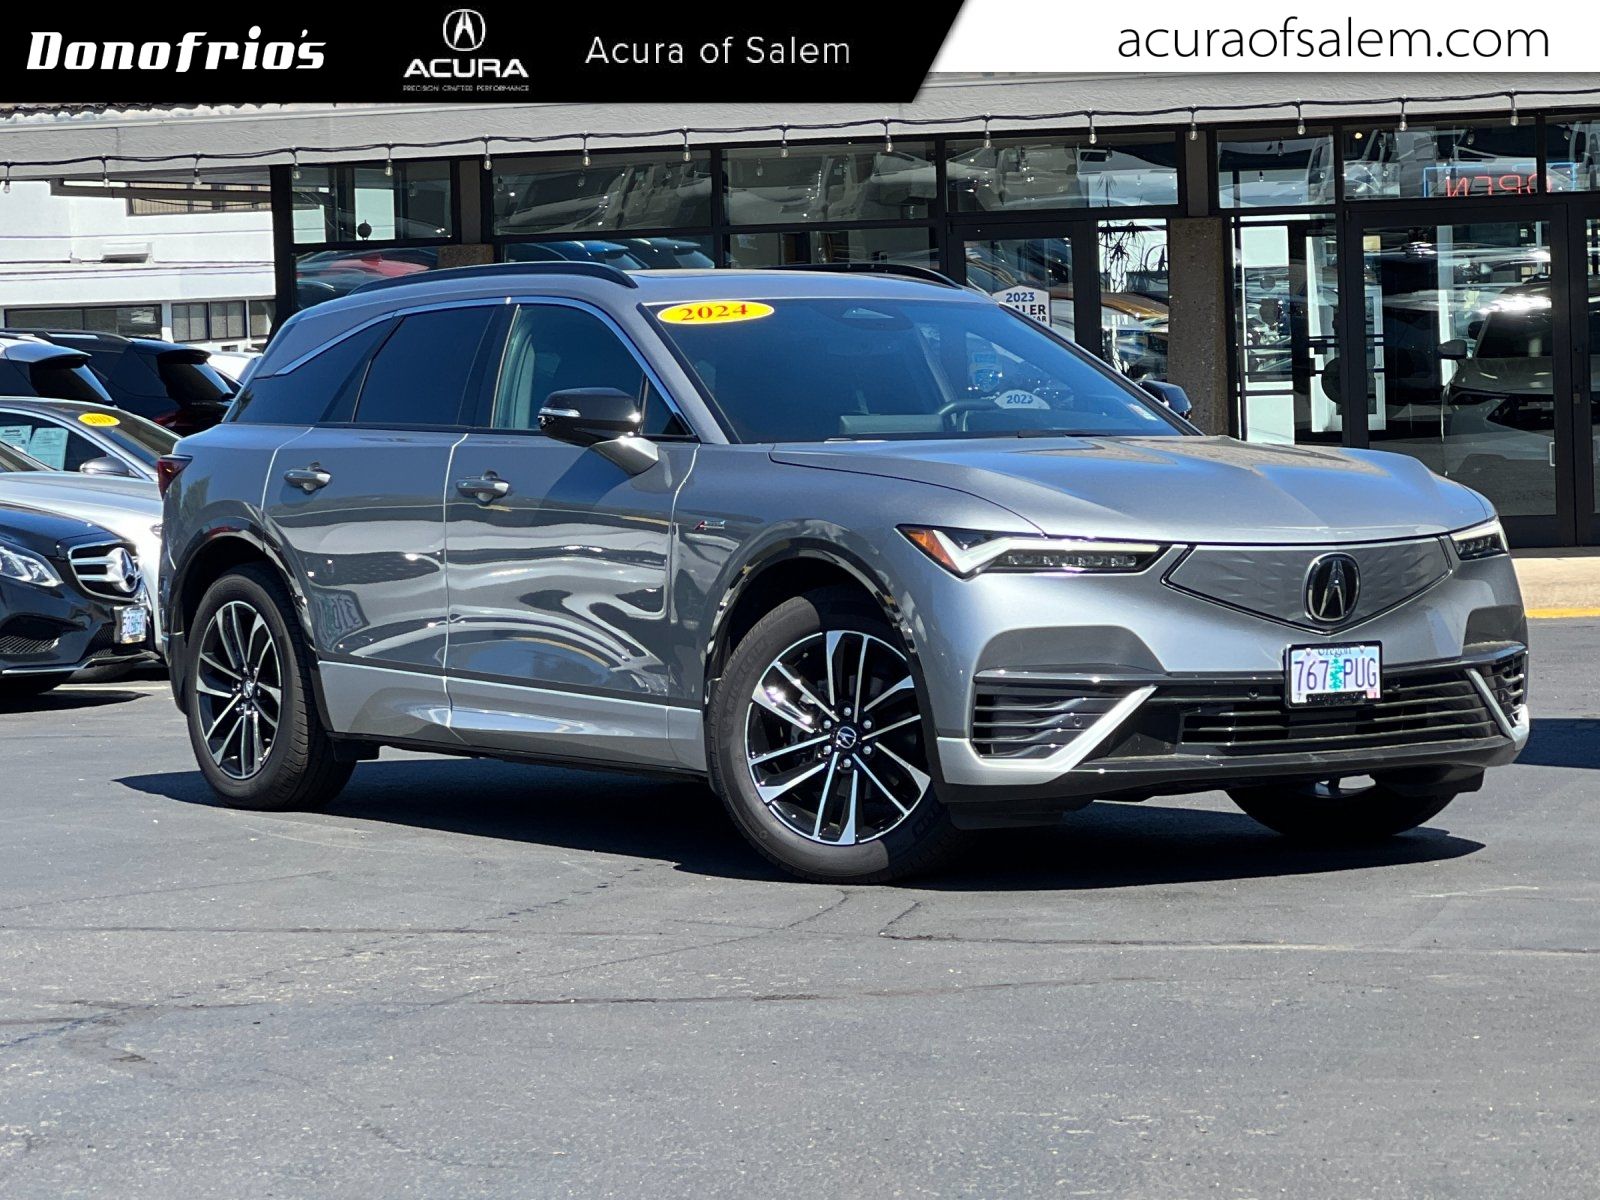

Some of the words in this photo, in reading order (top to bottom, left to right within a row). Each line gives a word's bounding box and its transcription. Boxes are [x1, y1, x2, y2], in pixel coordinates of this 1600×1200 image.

[1006, 292, 1035, 302] 2023
[680, 303, 748, 321] 2024
[1006, 393, 1034, 404] 2023
[1293, 659, 1329, 692] 767
[1343, 657, 1377, 689] PUG
